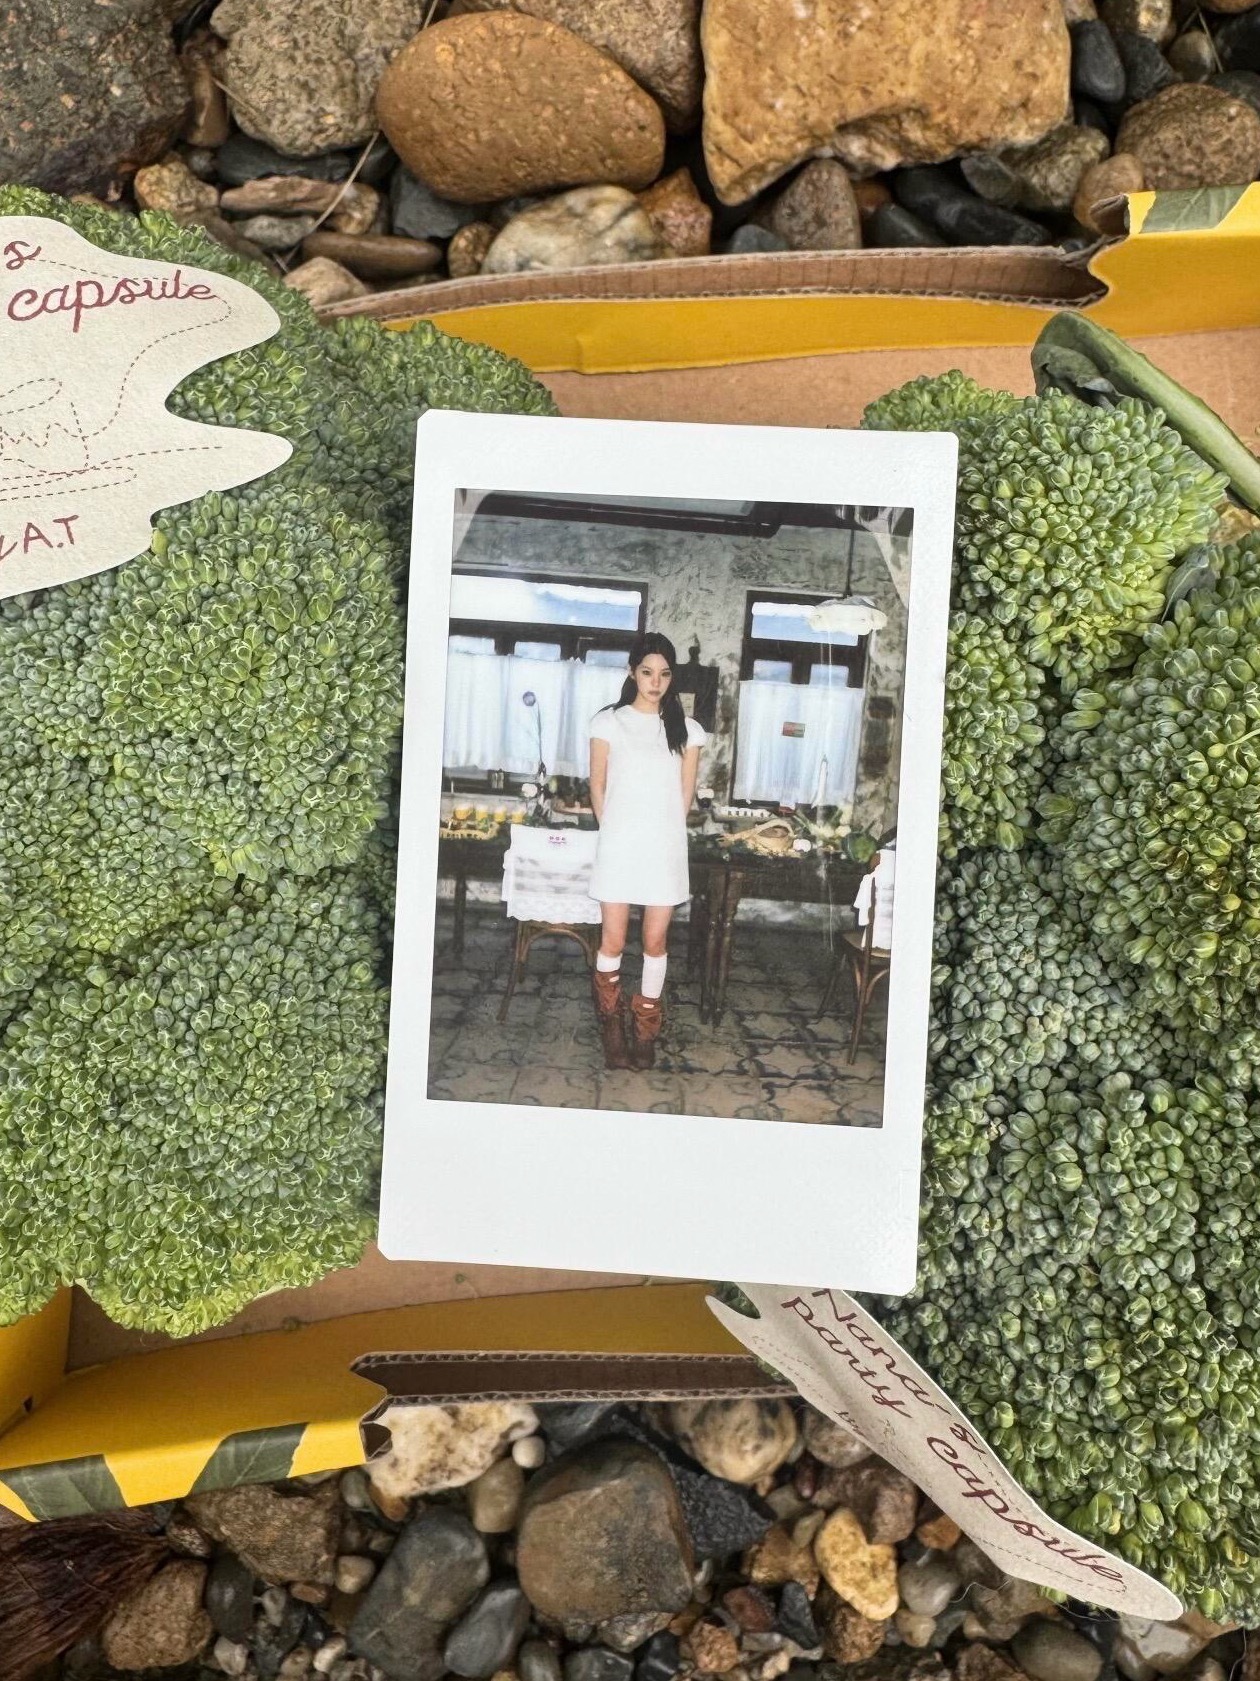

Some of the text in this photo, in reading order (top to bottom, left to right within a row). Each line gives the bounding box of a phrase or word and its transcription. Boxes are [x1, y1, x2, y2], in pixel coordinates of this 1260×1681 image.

[8, 269, 217, 333] capsule
[781, 1296, 1124, 1584] party capsule
